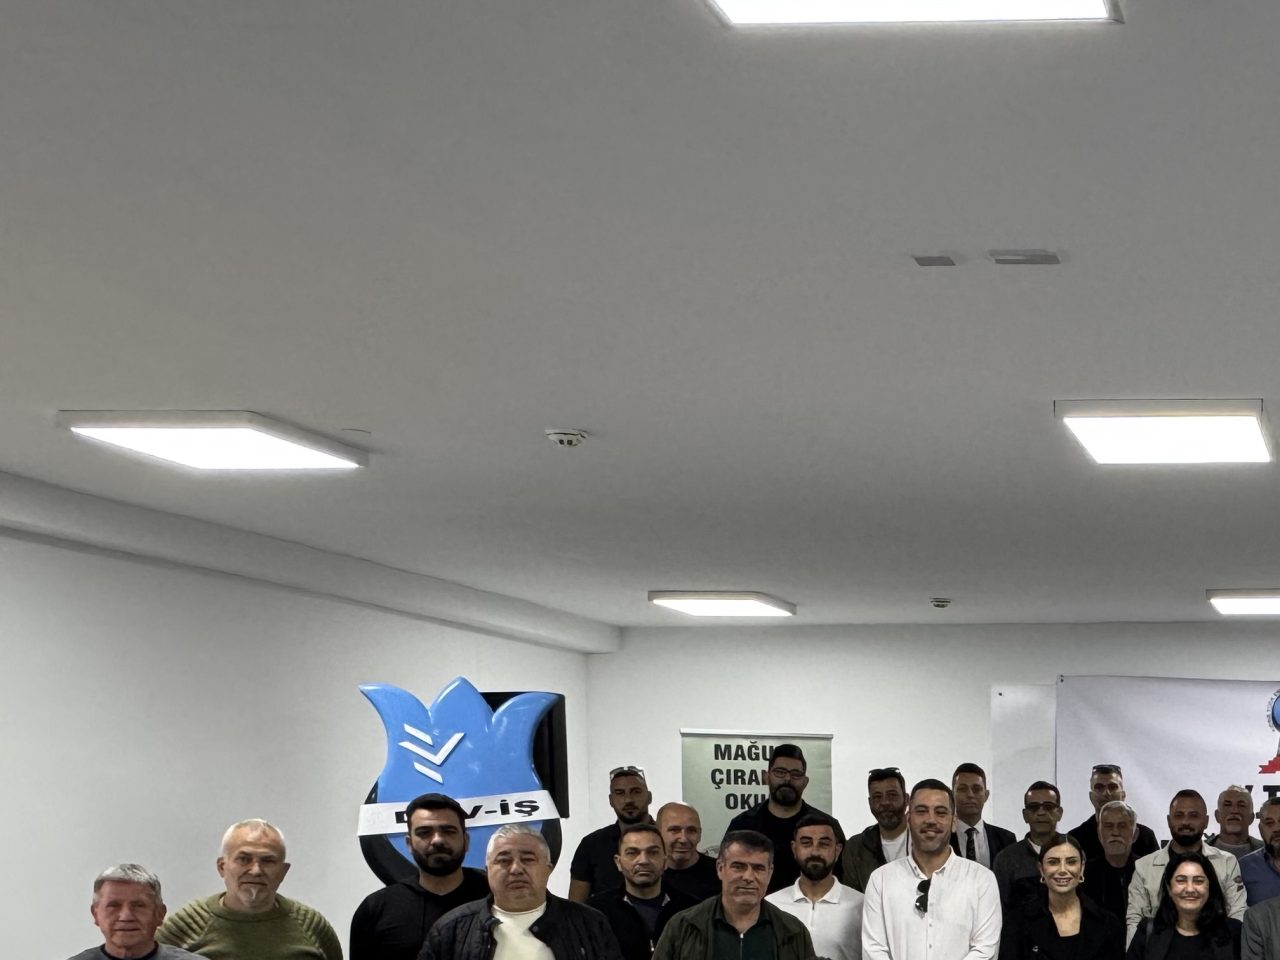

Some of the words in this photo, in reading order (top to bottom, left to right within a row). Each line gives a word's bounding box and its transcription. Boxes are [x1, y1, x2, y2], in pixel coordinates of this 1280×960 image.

[714, 741, 774, 761] MAĞU
[711, 768, 769, 789] ÇIRA
[395, 799, 540, 824] DV-İŞ
[726, 793, 766, 810] OKU
